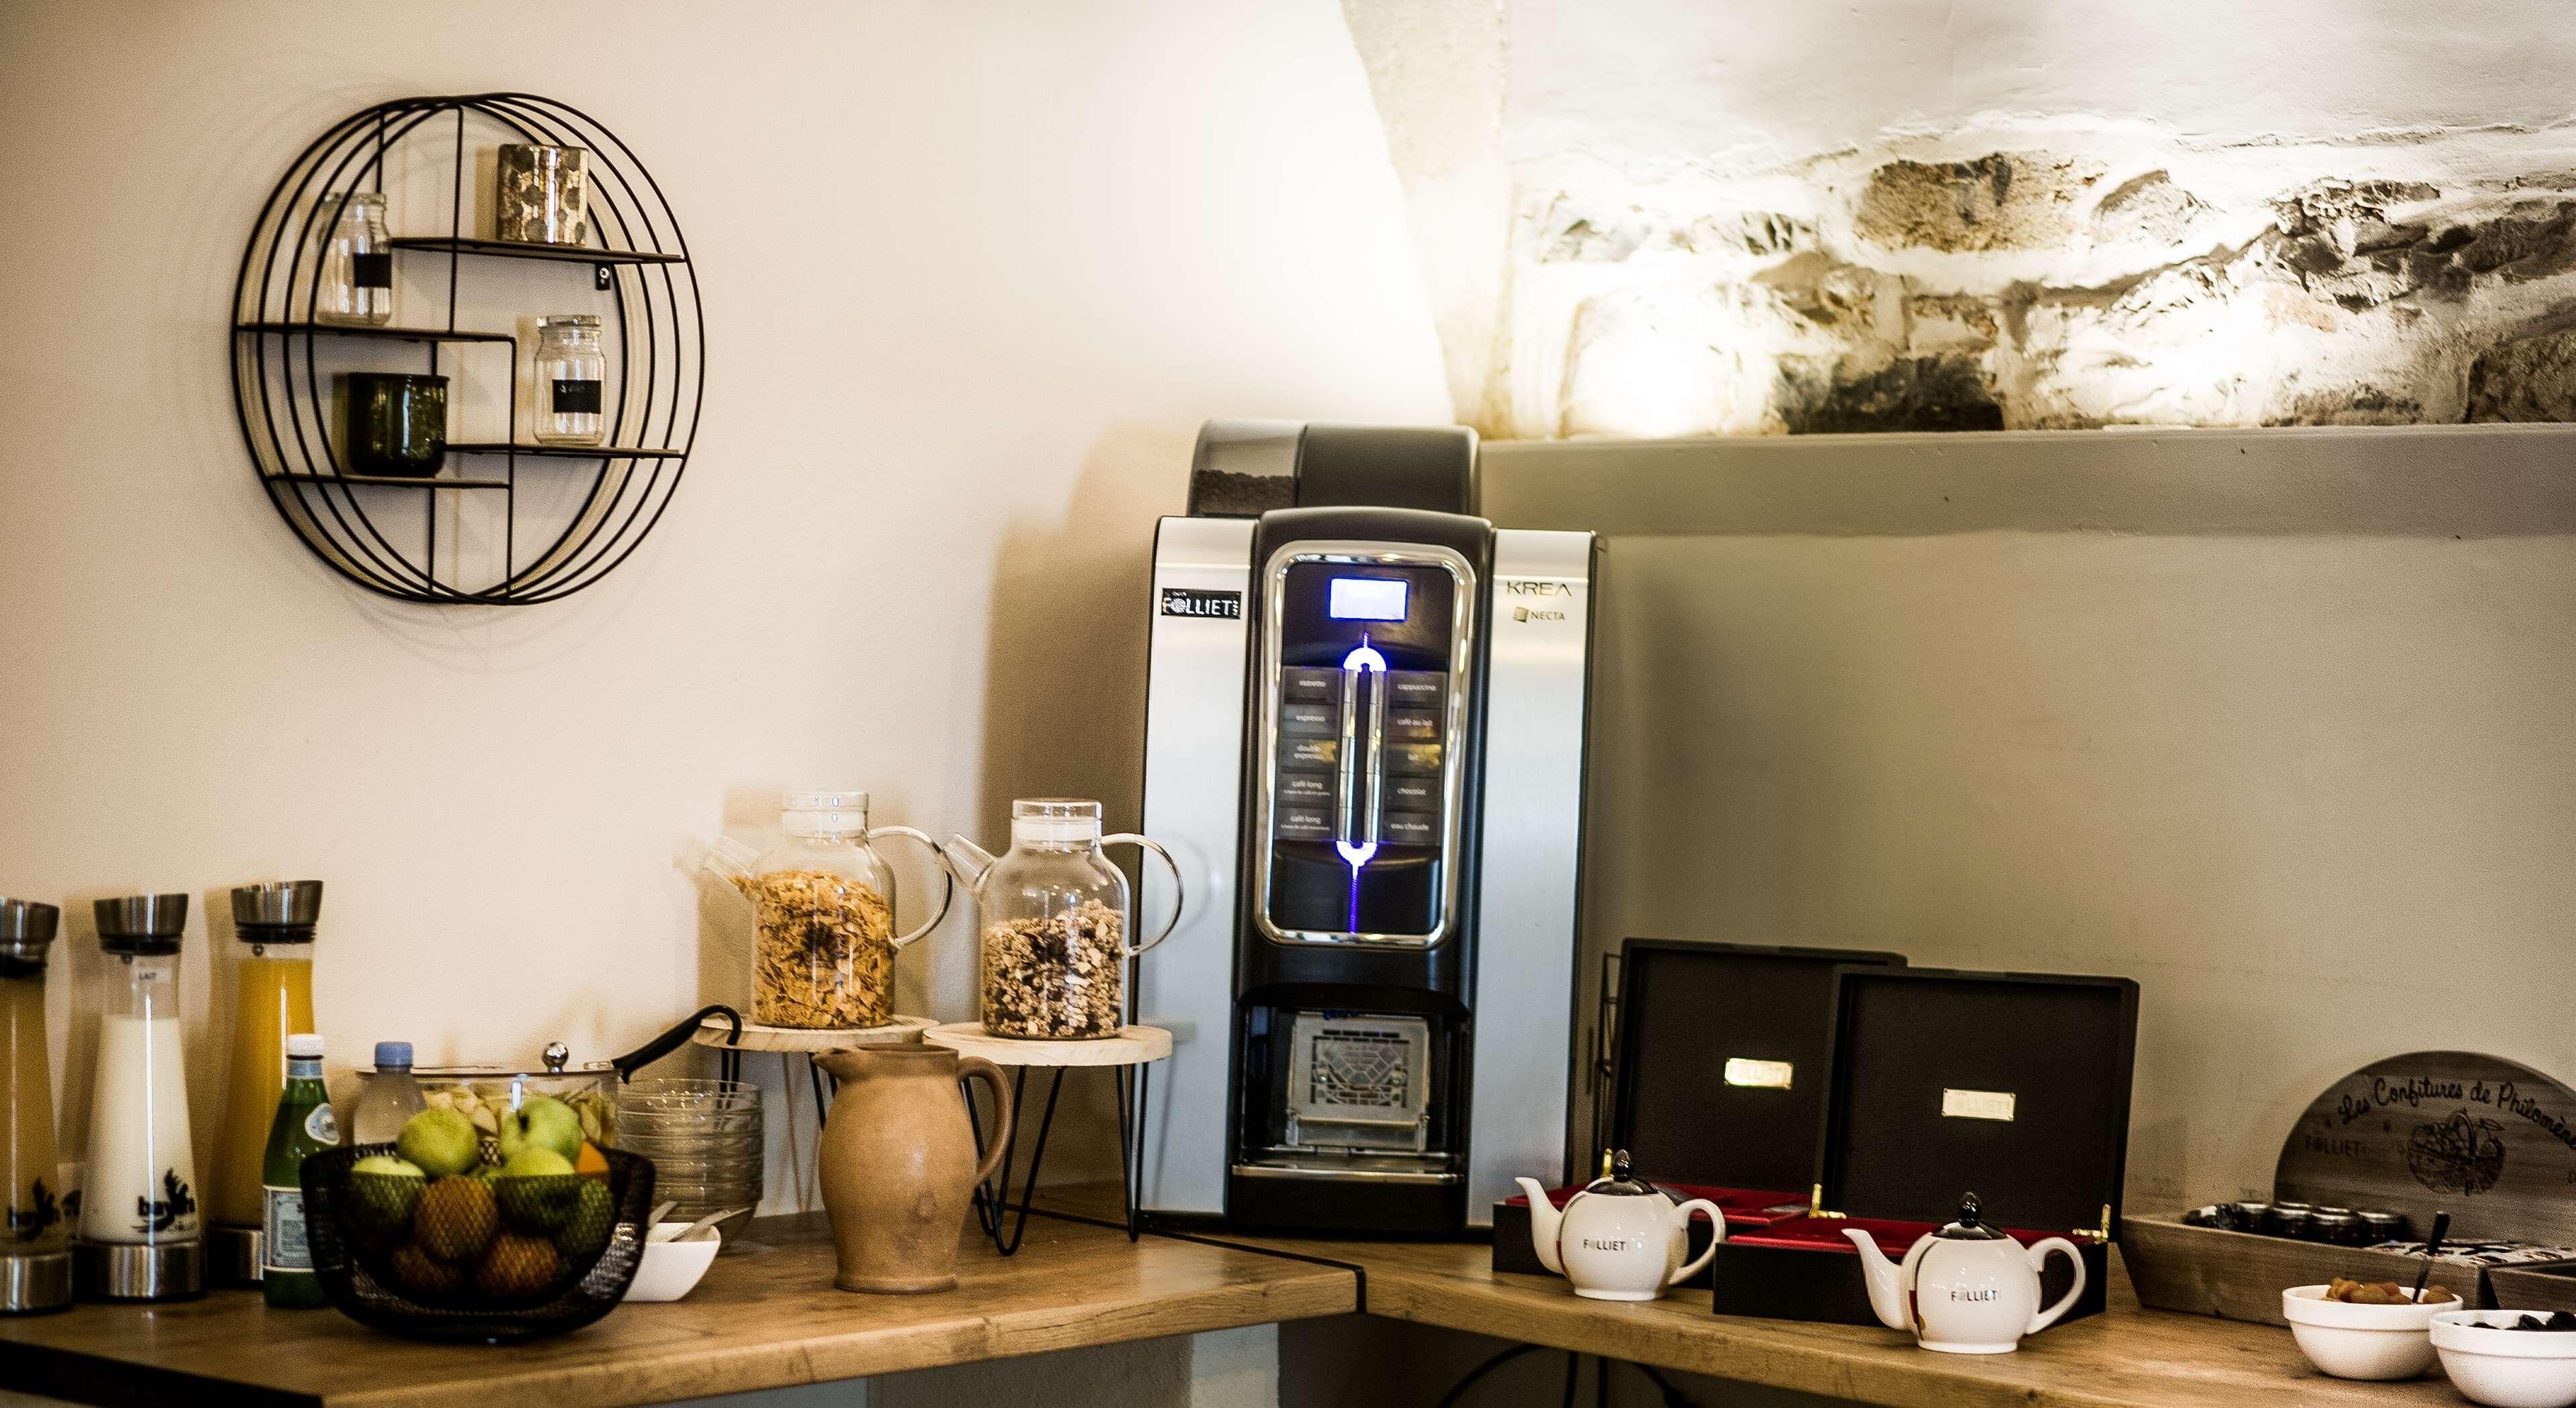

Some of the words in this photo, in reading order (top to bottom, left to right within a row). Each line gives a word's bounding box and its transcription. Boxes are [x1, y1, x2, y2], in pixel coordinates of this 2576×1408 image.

[1507, 581, 1572, 597] KREA
[1162, 597, 1233, 615] FOLLIET
[1531, 611, 1565, 620] NECTA
[1397, 684, 1437, 692] cappuccino
[2337, 1093, 2371, 1125] Les
[2373, 1076, 2463, 1107] Confitures
[2469, 1080, 2491, 1105] de
